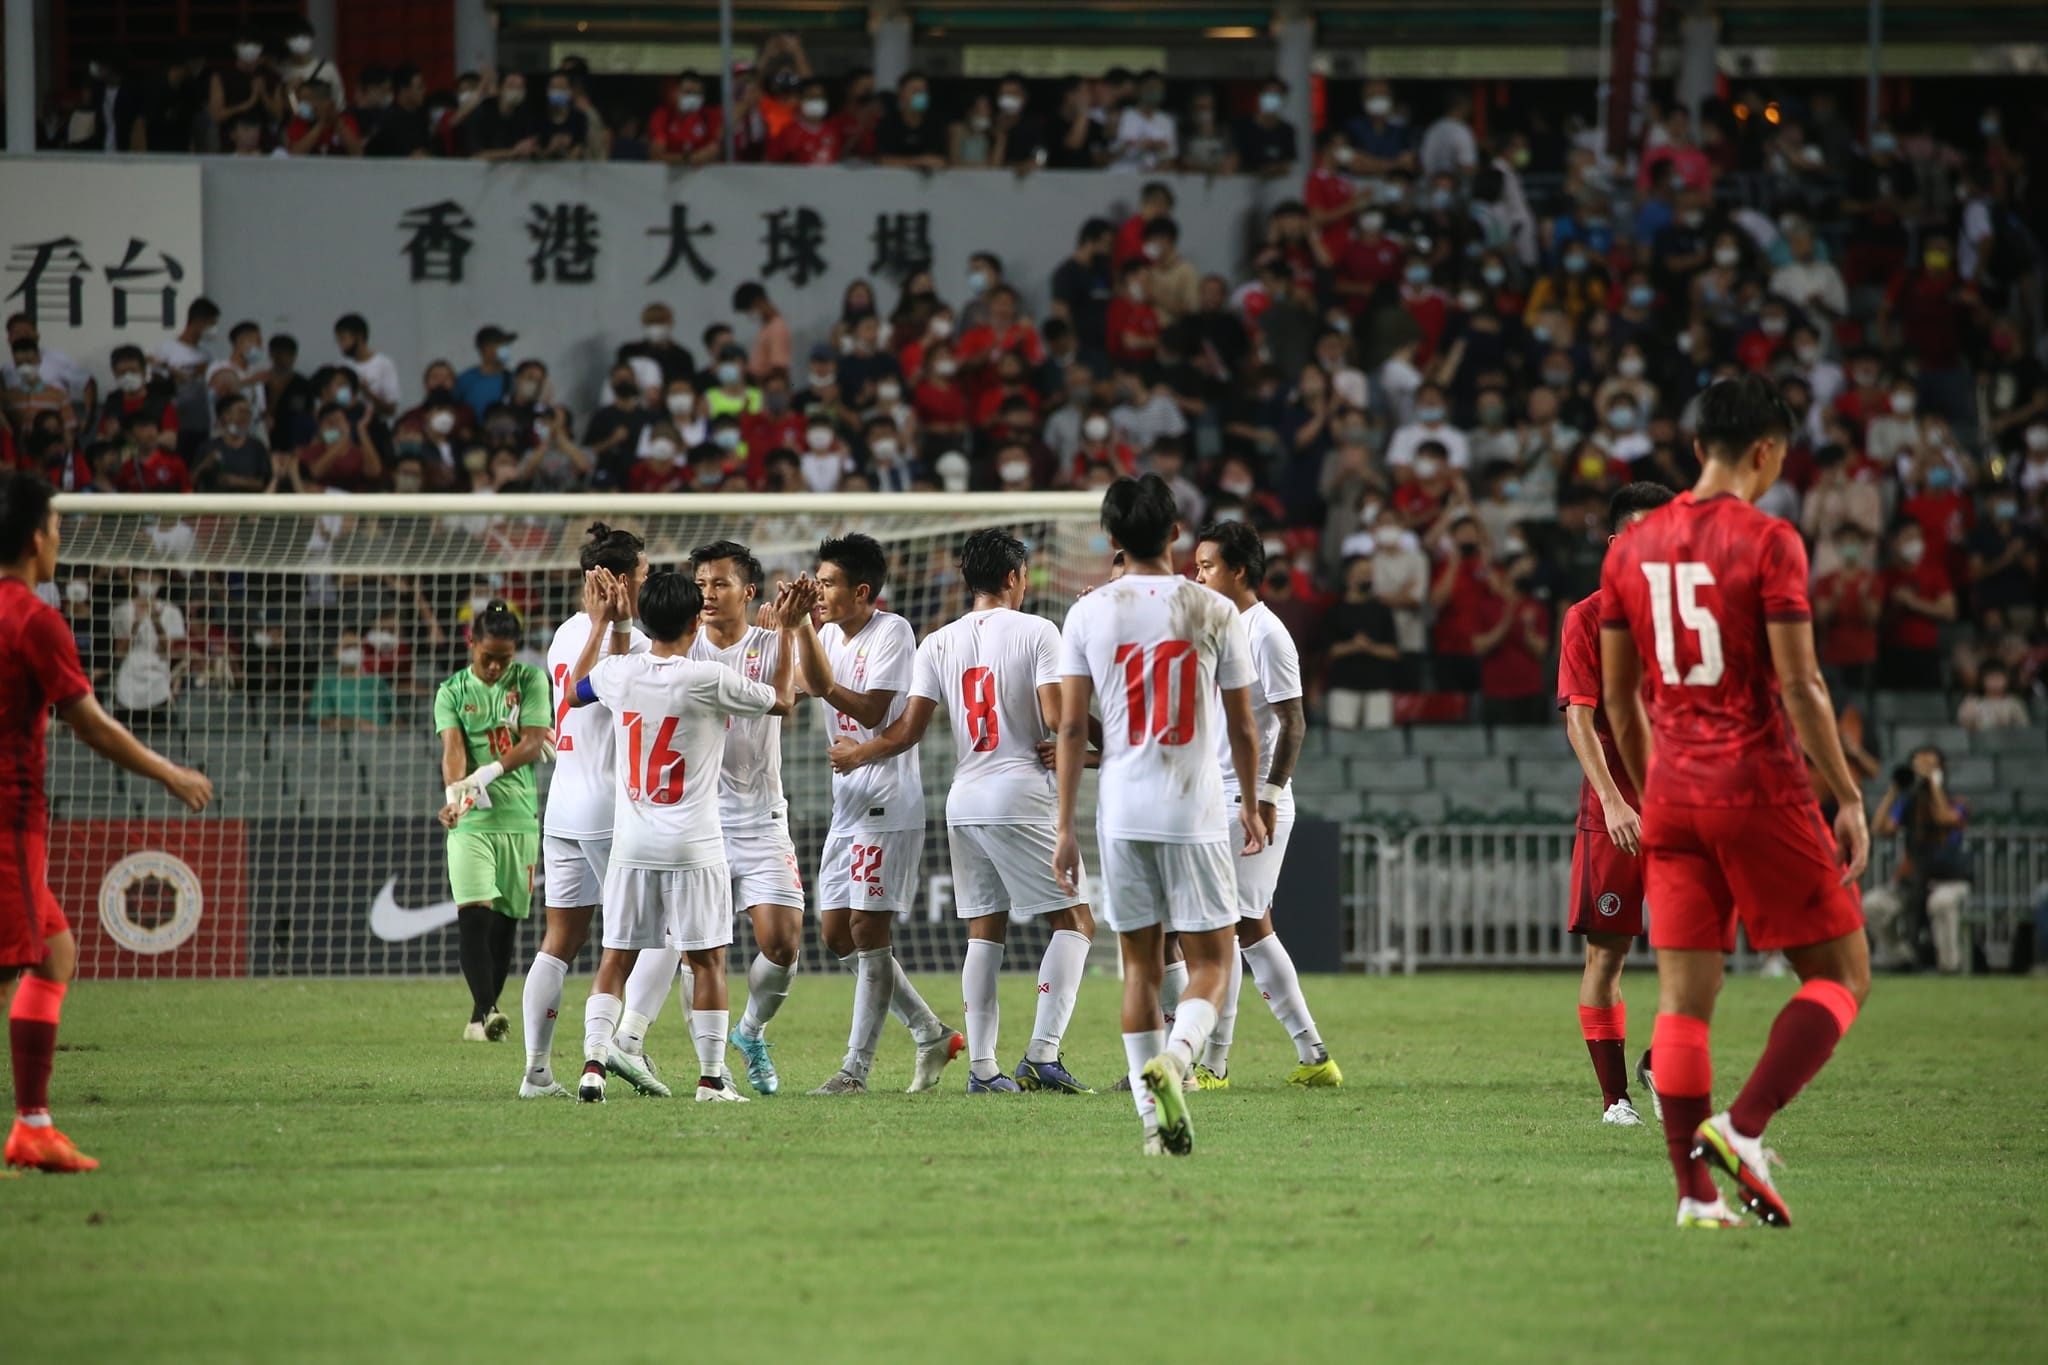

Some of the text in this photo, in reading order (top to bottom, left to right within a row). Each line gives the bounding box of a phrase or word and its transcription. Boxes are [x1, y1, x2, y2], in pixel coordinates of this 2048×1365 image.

[5, 236, 185, 329] 看台
[1640, 561, 1726, 686] 15
[961, 666, 999, 752] 8
[1114, 639, 1198, 747] 10
[622, 711, 686, 805] 16
[850, 844, 883, 883] 22
